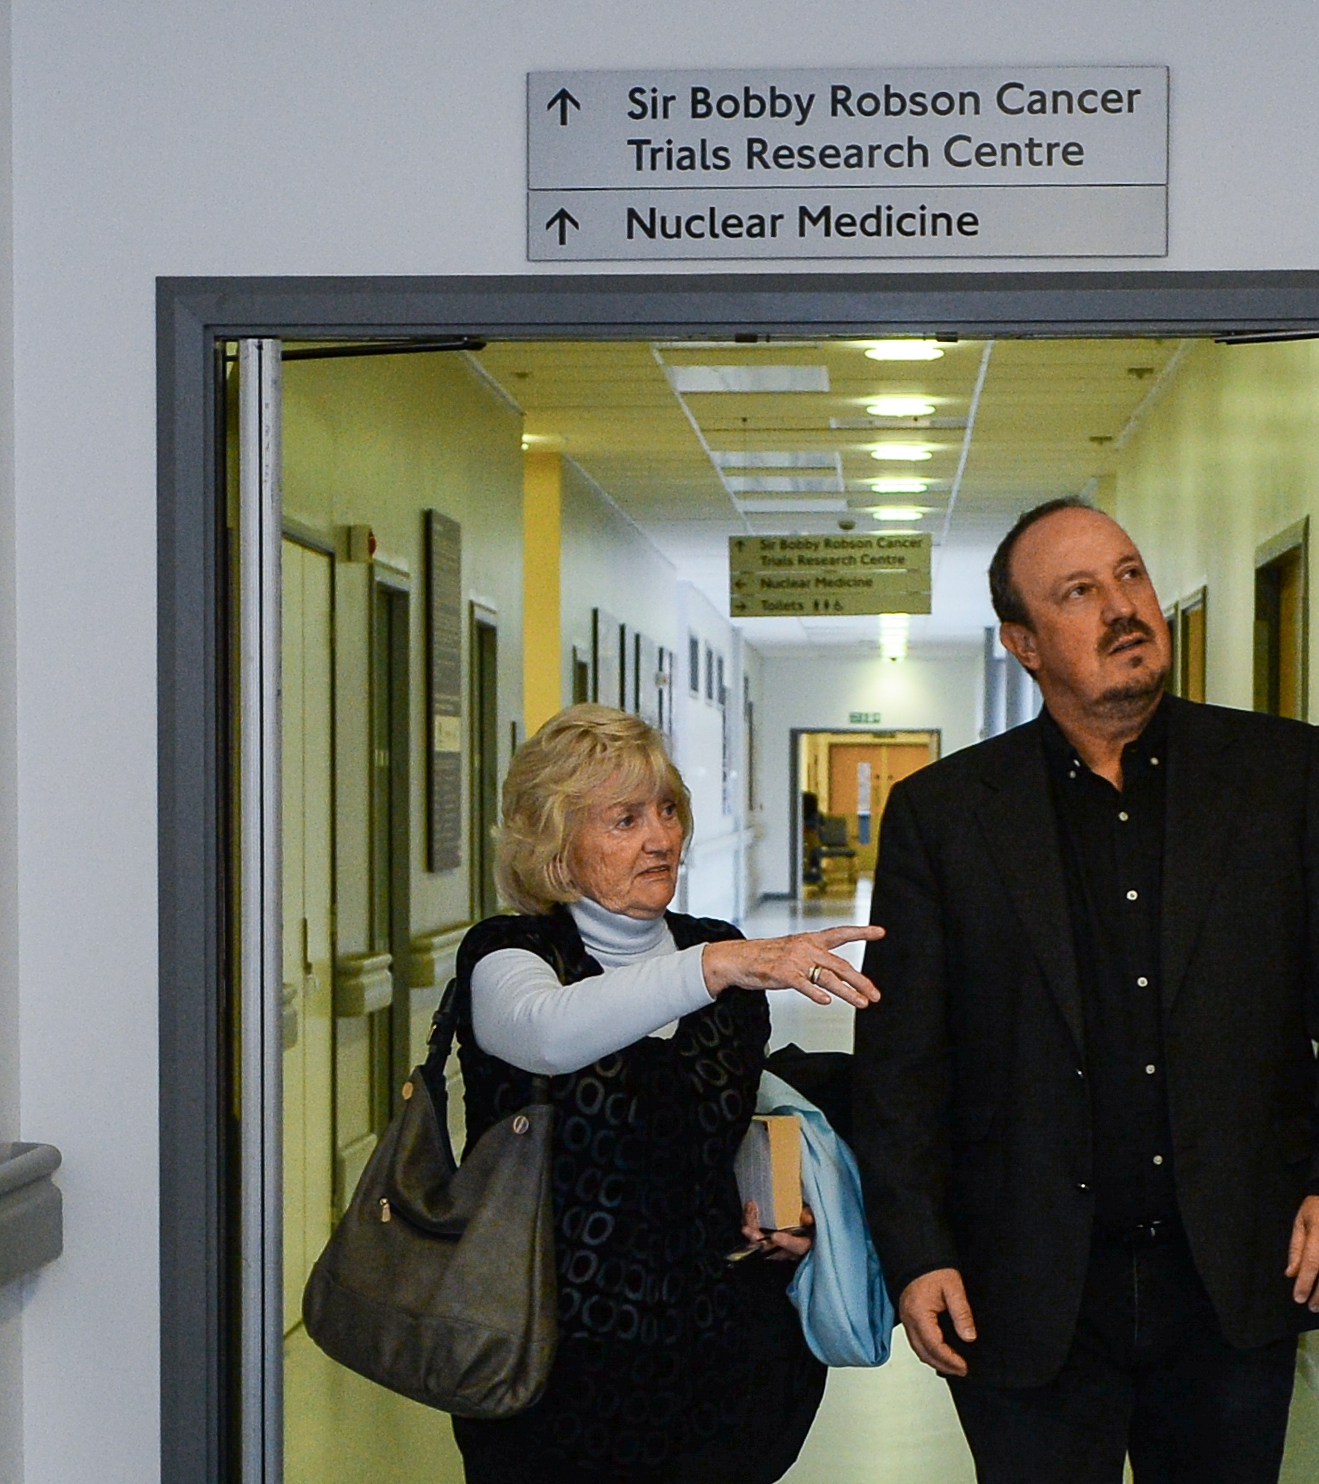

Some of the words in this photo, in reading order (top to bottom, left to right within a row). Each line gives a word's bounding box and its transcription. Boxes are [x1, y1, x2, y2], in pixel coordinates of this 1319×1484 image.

[627, 86, 677, 121] Sir
[690, 85, 817, 126] Bobby
[829, 84, 981, 118] Robson
[995, 81, 1142, 116] Cancer
[626, 137, 731, 172] Trials
[746, 135, 930, 170] Research
[943, 134, 1085, 168] Centre
[626, 206, 785, 240] Nuclear
[798, 204, 980, 238] Medicine
[760, 538, 777, 551] Sir
[780, 538, 819, 551] Bobby
[824, 537, 873, 549] Robson
[876, 536, 923, 549] Cancer
[761, 555, 794, 567] Trials
[797, 554, 857, 566] Research
[860, 553, 906, 565] Centre
[761, 577, 811, 589] Nuclear
[814, 576, 873, 588] Medicine
[761, 599, 804, 611] Toilets
